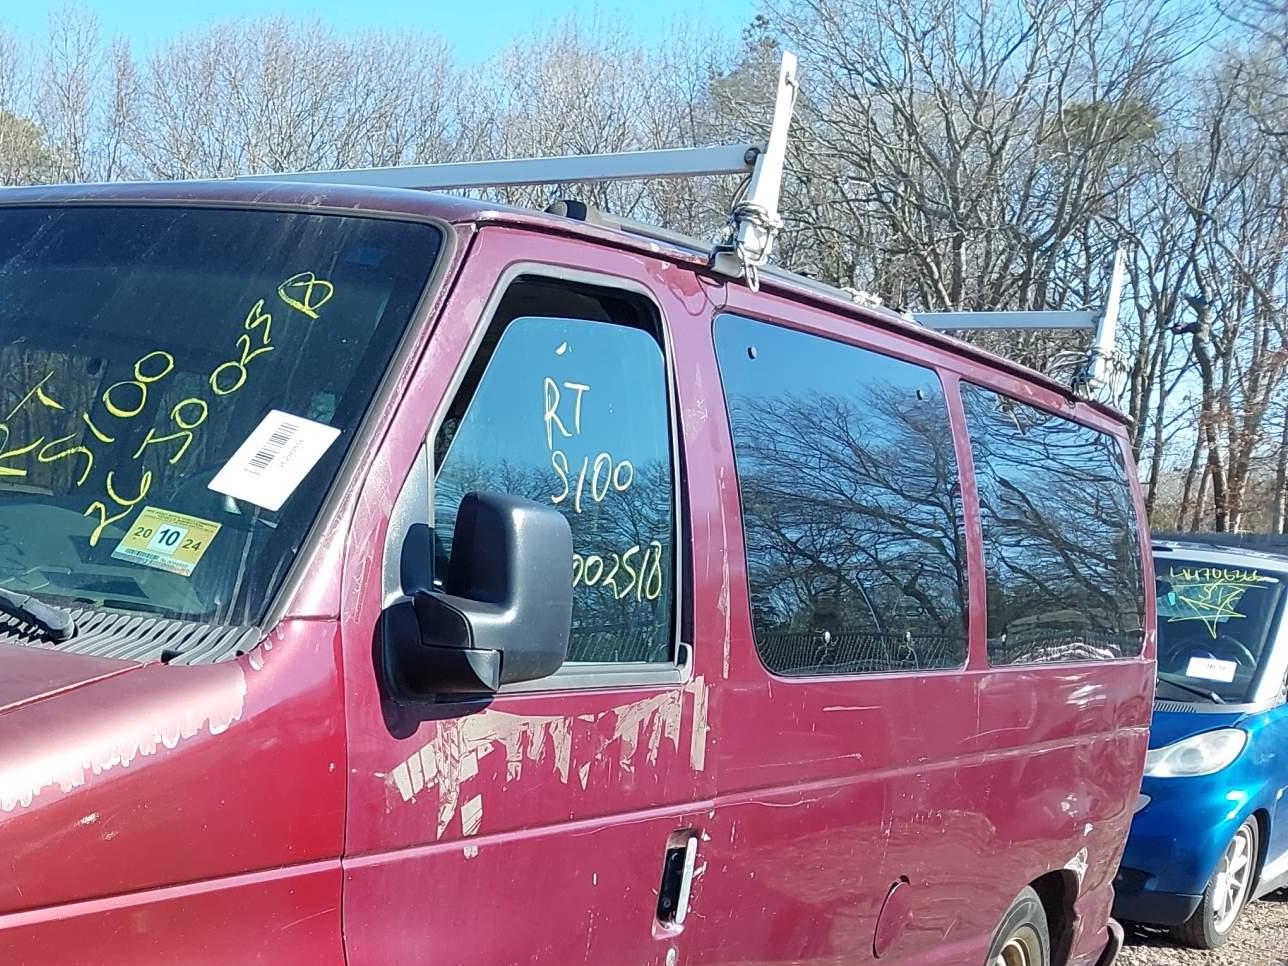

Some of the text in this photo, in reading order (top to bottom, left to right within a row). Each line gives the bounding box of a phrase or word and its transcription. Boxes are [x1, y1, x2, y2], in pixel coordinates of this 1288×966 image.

[38, 350, 174, 487] S100
[543, 377, 590, 450] RT
[551, 450, 634, 514] S100
[134, 526, 202, 552] 20 10 24
